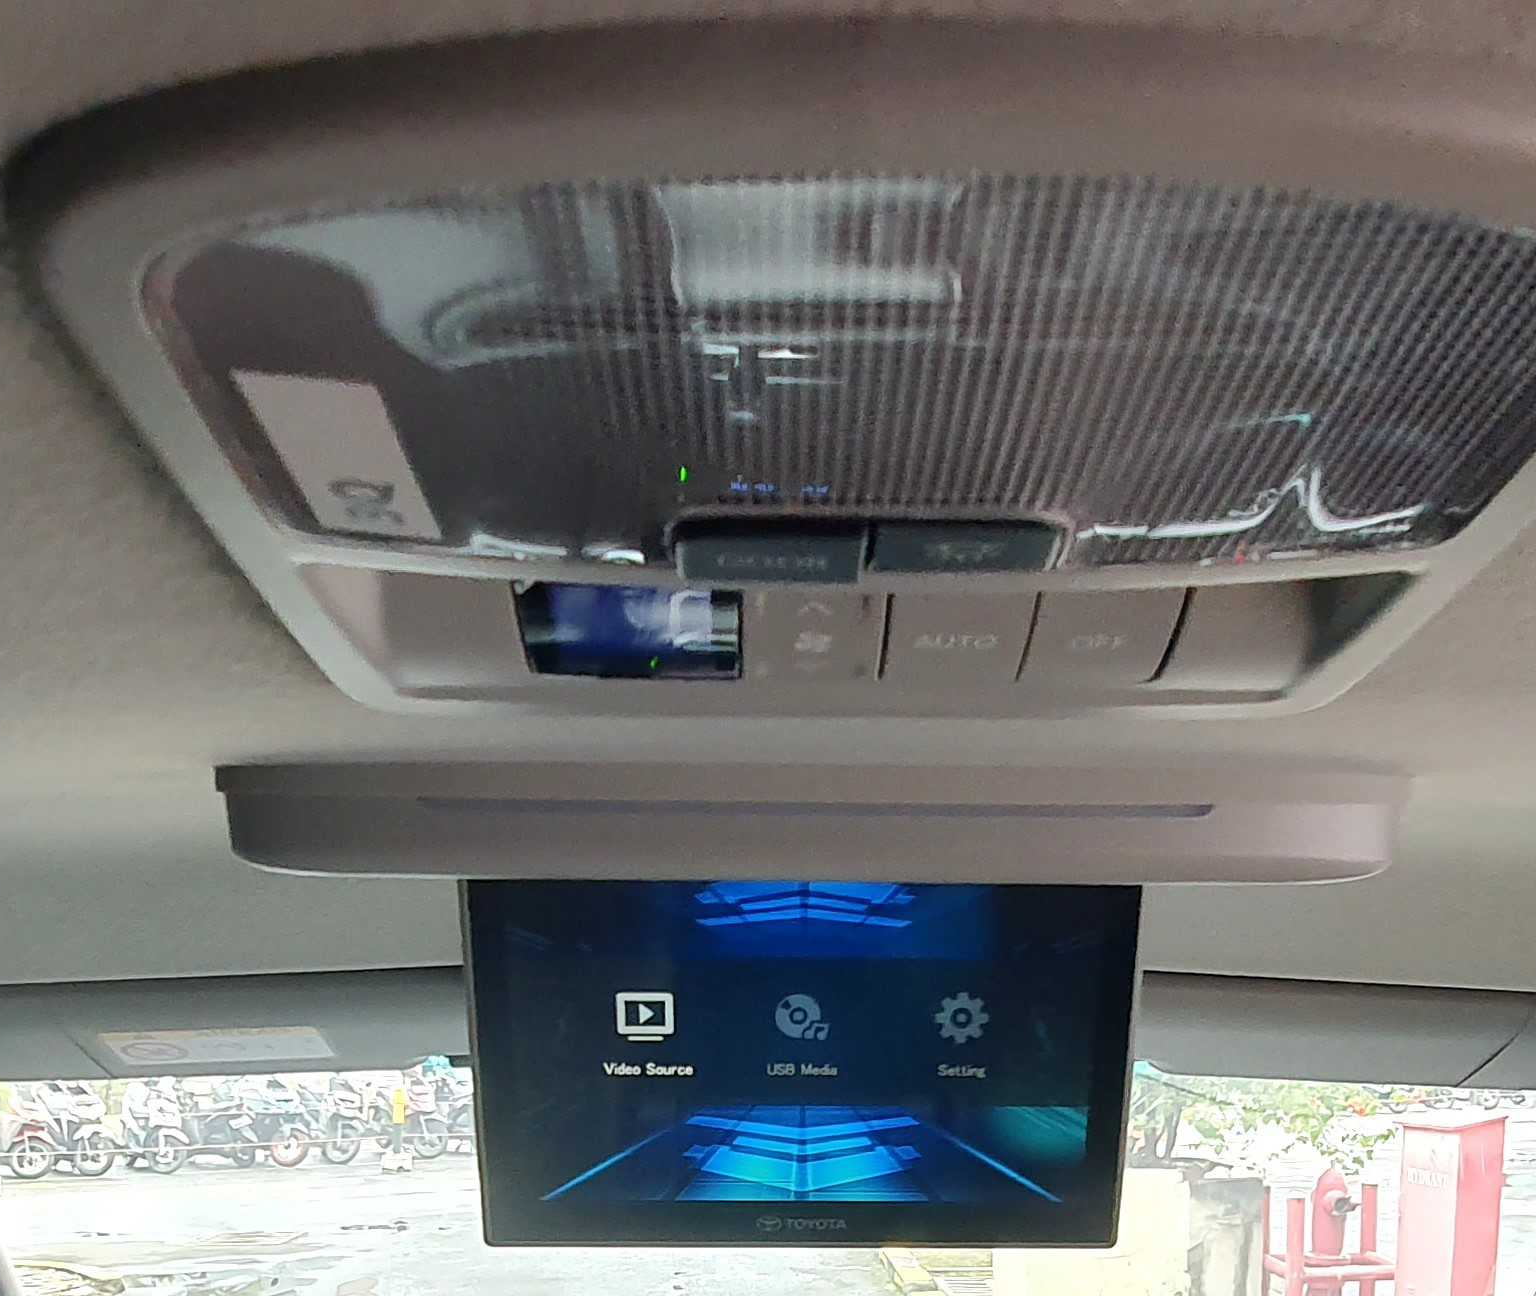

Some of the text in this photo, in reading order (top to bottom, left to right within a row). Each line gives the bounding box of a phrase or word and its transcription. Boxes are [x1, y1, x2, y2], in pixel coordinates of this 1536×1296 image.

[915, 633, 999, 650] AUTO
[603, 1063, 694, 1076] Video Source
[767, 1063, 838, 1076] USB Media
[937, 1064, 986, 1079] Setting
[787, 1219, 847, 1230] TOYOTA
